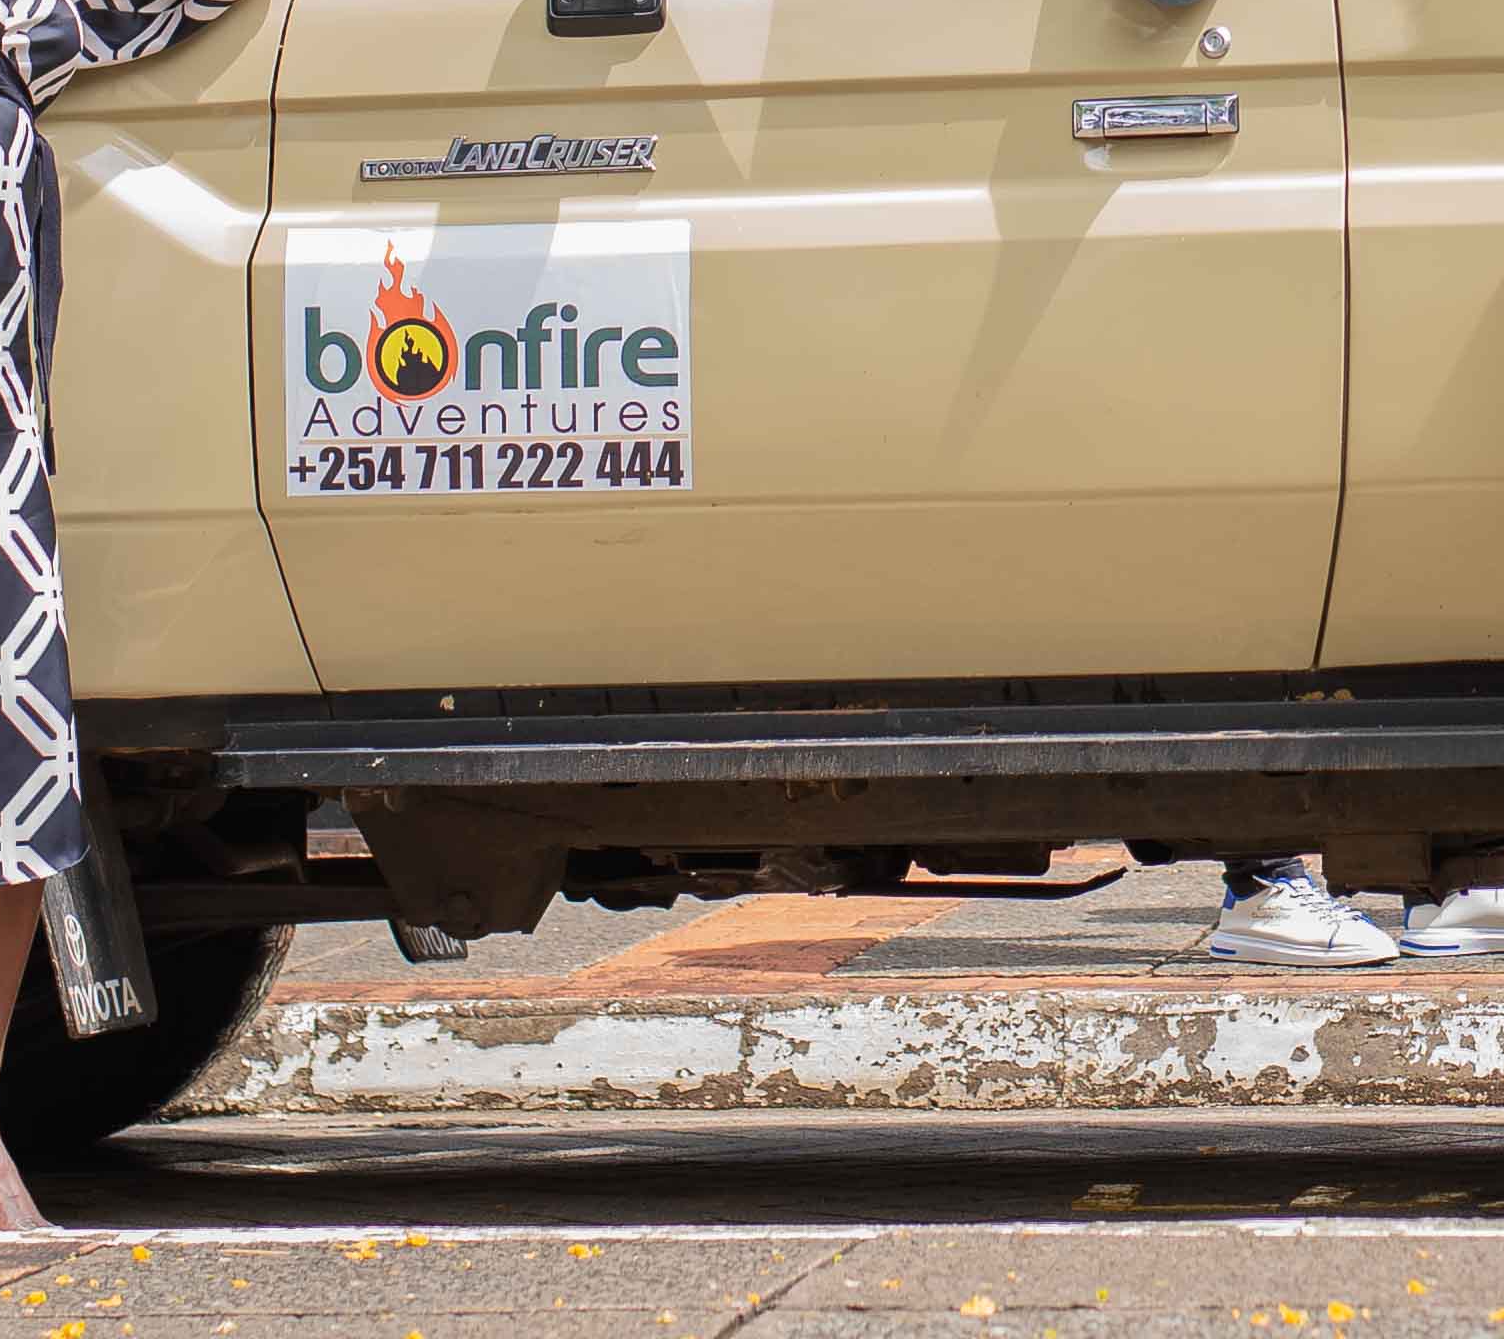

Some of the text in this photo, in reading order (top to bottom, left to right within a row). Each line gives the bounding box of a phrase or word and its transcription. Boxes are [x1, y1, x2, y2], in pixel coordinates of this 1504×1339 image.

[365, 161, 439, 177] TOYOTA
[303, 394, 680, 437] Adventures
[289, 440, 685, 491] +254 711 222 444
